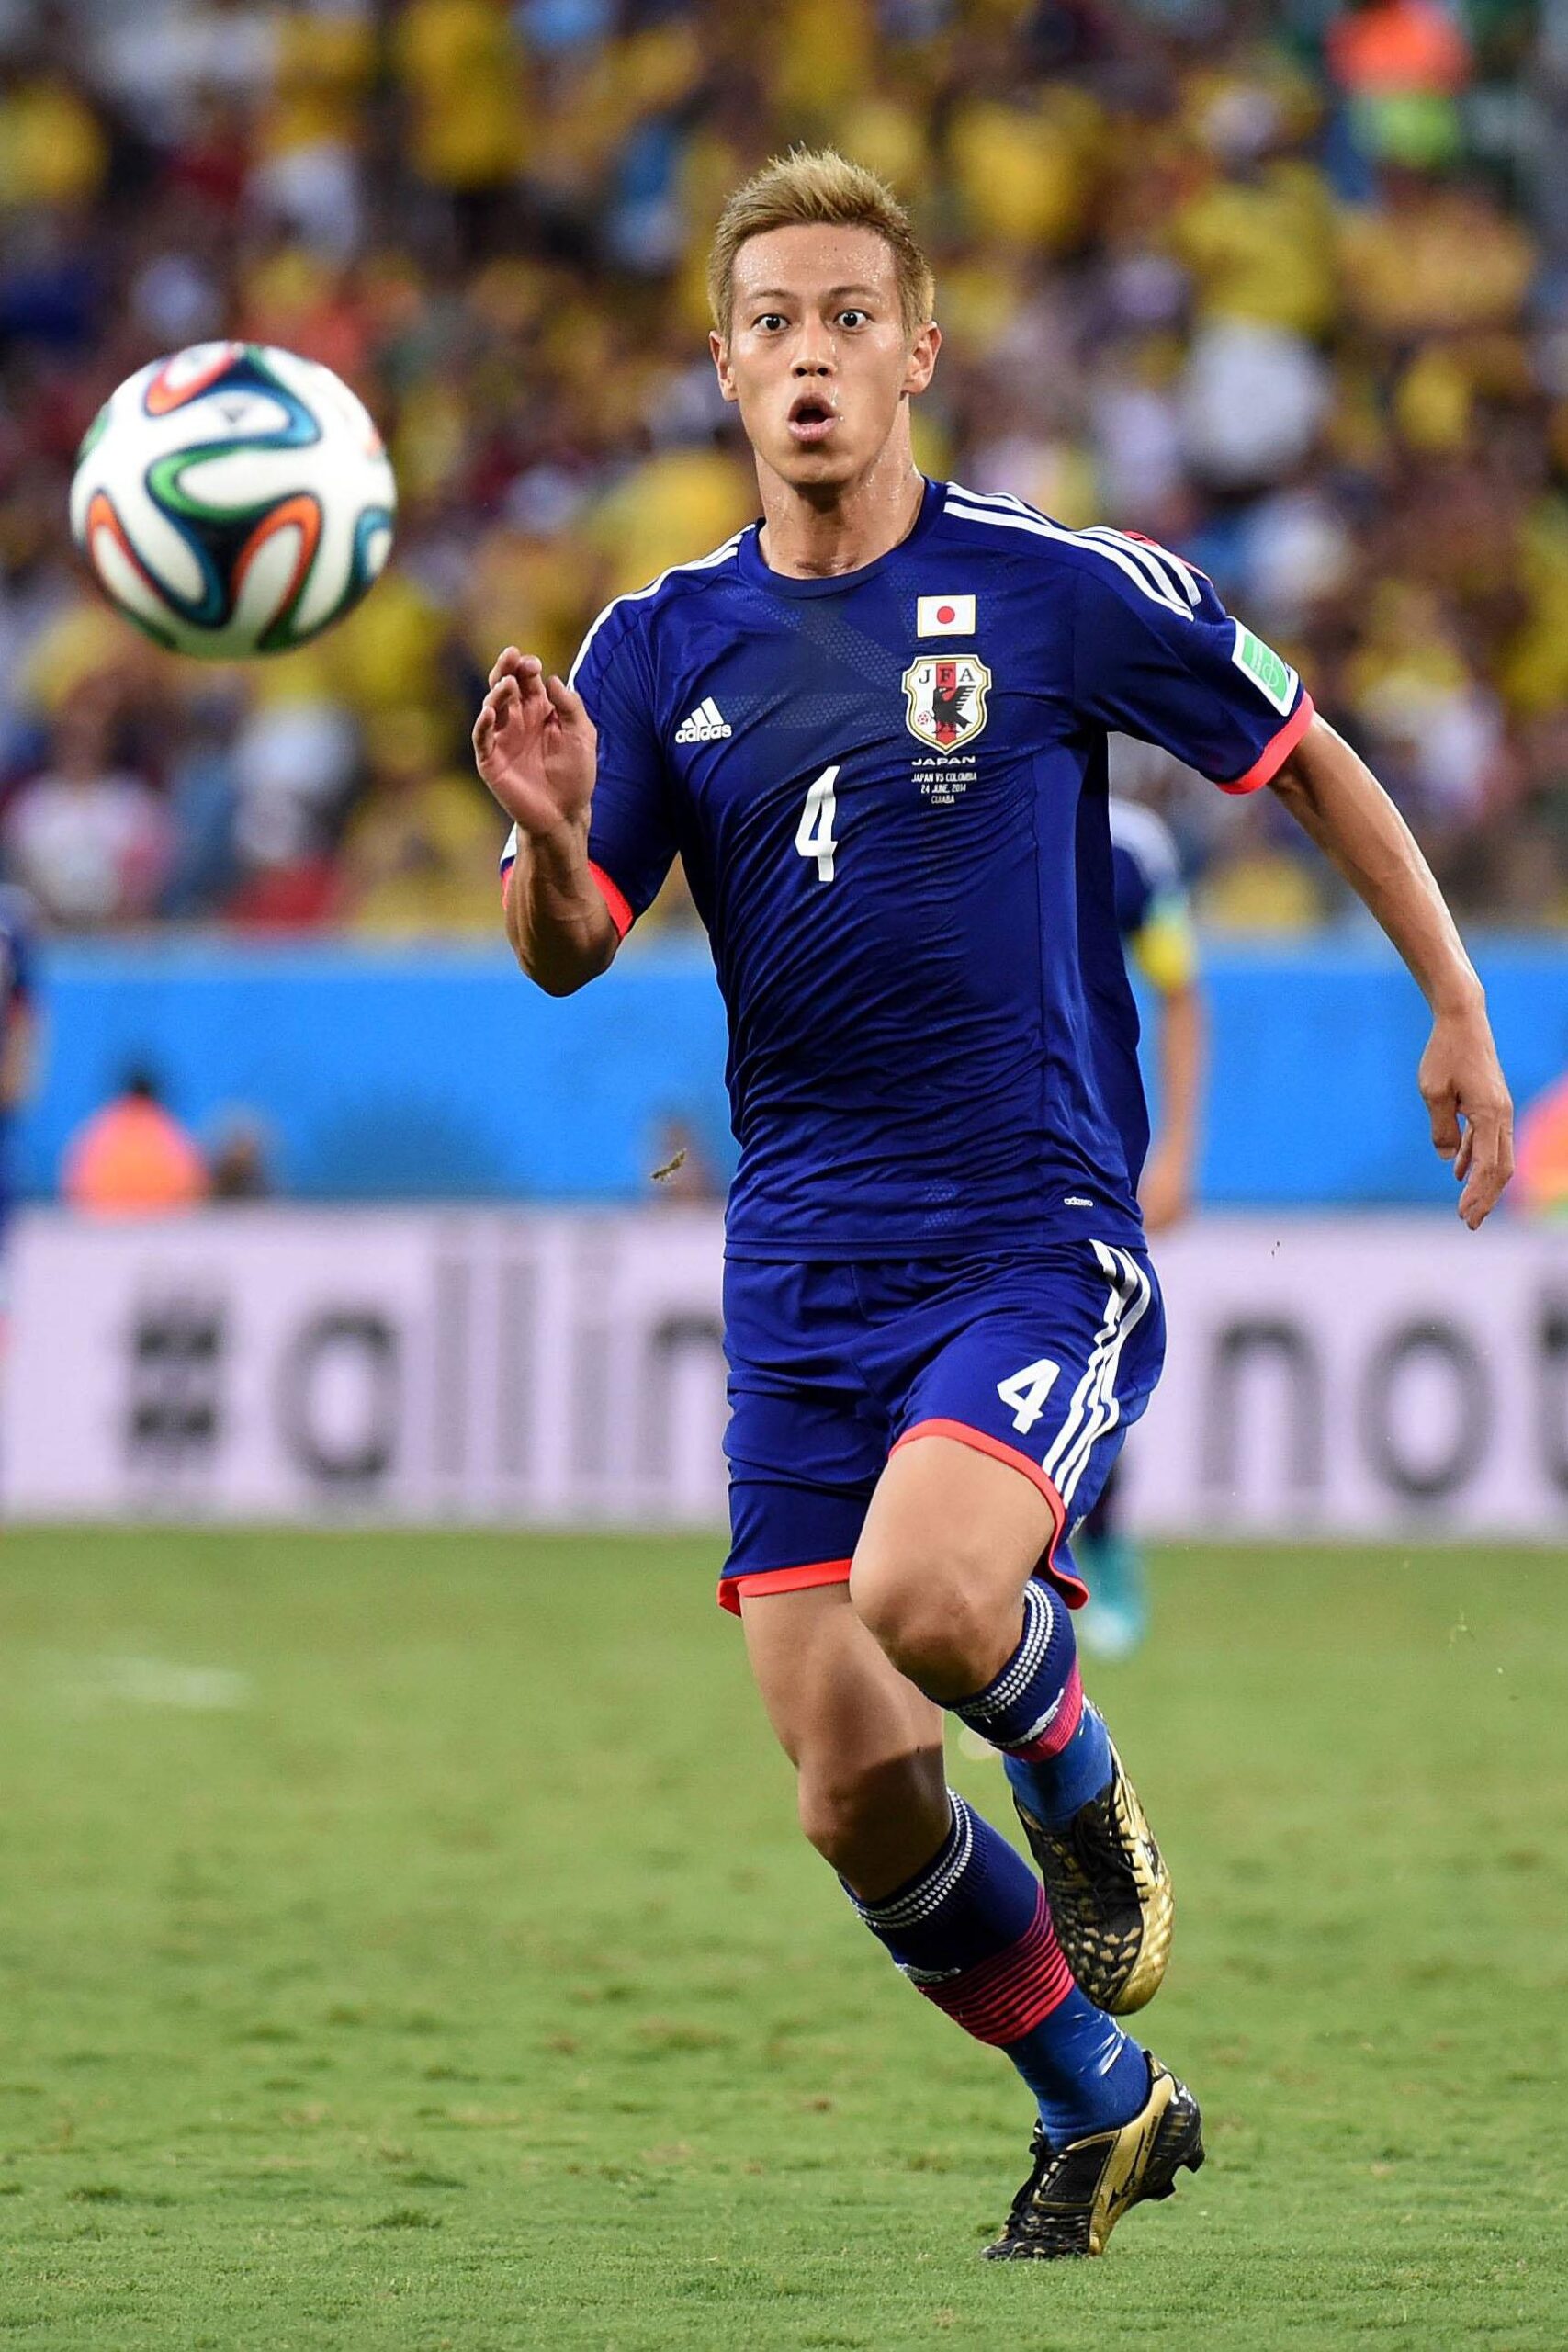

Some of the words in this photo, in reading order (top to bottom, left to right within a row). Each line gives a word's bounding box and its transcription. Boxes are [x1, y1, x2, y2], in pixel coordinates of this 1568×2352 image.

[919, 668, 975, 684] JFA
[675, 724, 732, 743] adidas
[911, 756, 976, 766] JAPAN
[911, 773, 934, 783] JAPAN
[935, 773, 944, 782] VS
[920, 784, 930, 794] 24
[794, 765, 840, 882] 4
[997, 1358, 1061, 1434] 4
